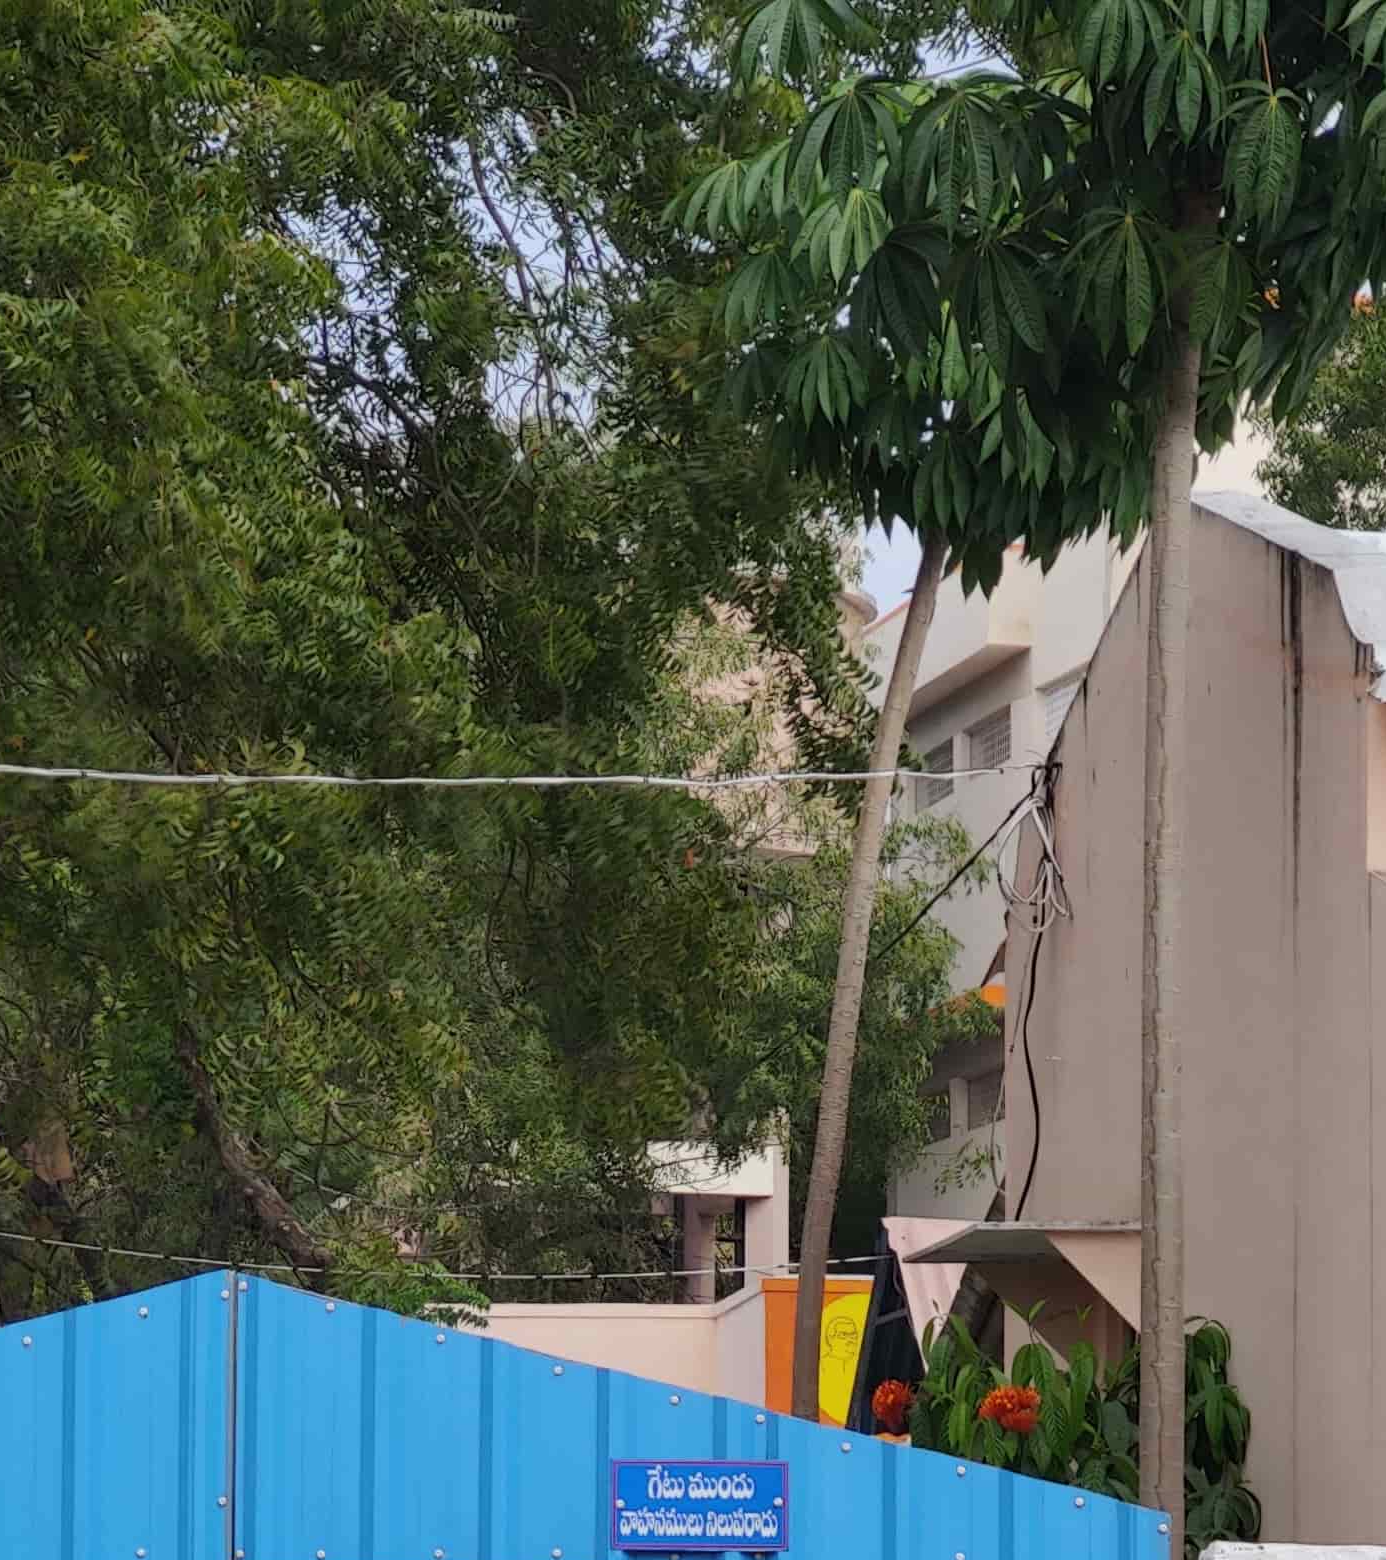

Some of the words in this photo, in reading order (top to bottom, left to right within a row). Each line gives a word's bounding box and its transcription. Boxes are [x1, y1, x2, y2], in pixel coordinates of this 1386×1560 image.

[647, 1464, 685, 1499] గేటు
[688, 1472, 755, 1500] ముందు
[620, 1506, 703, 1537] వాహనములు
